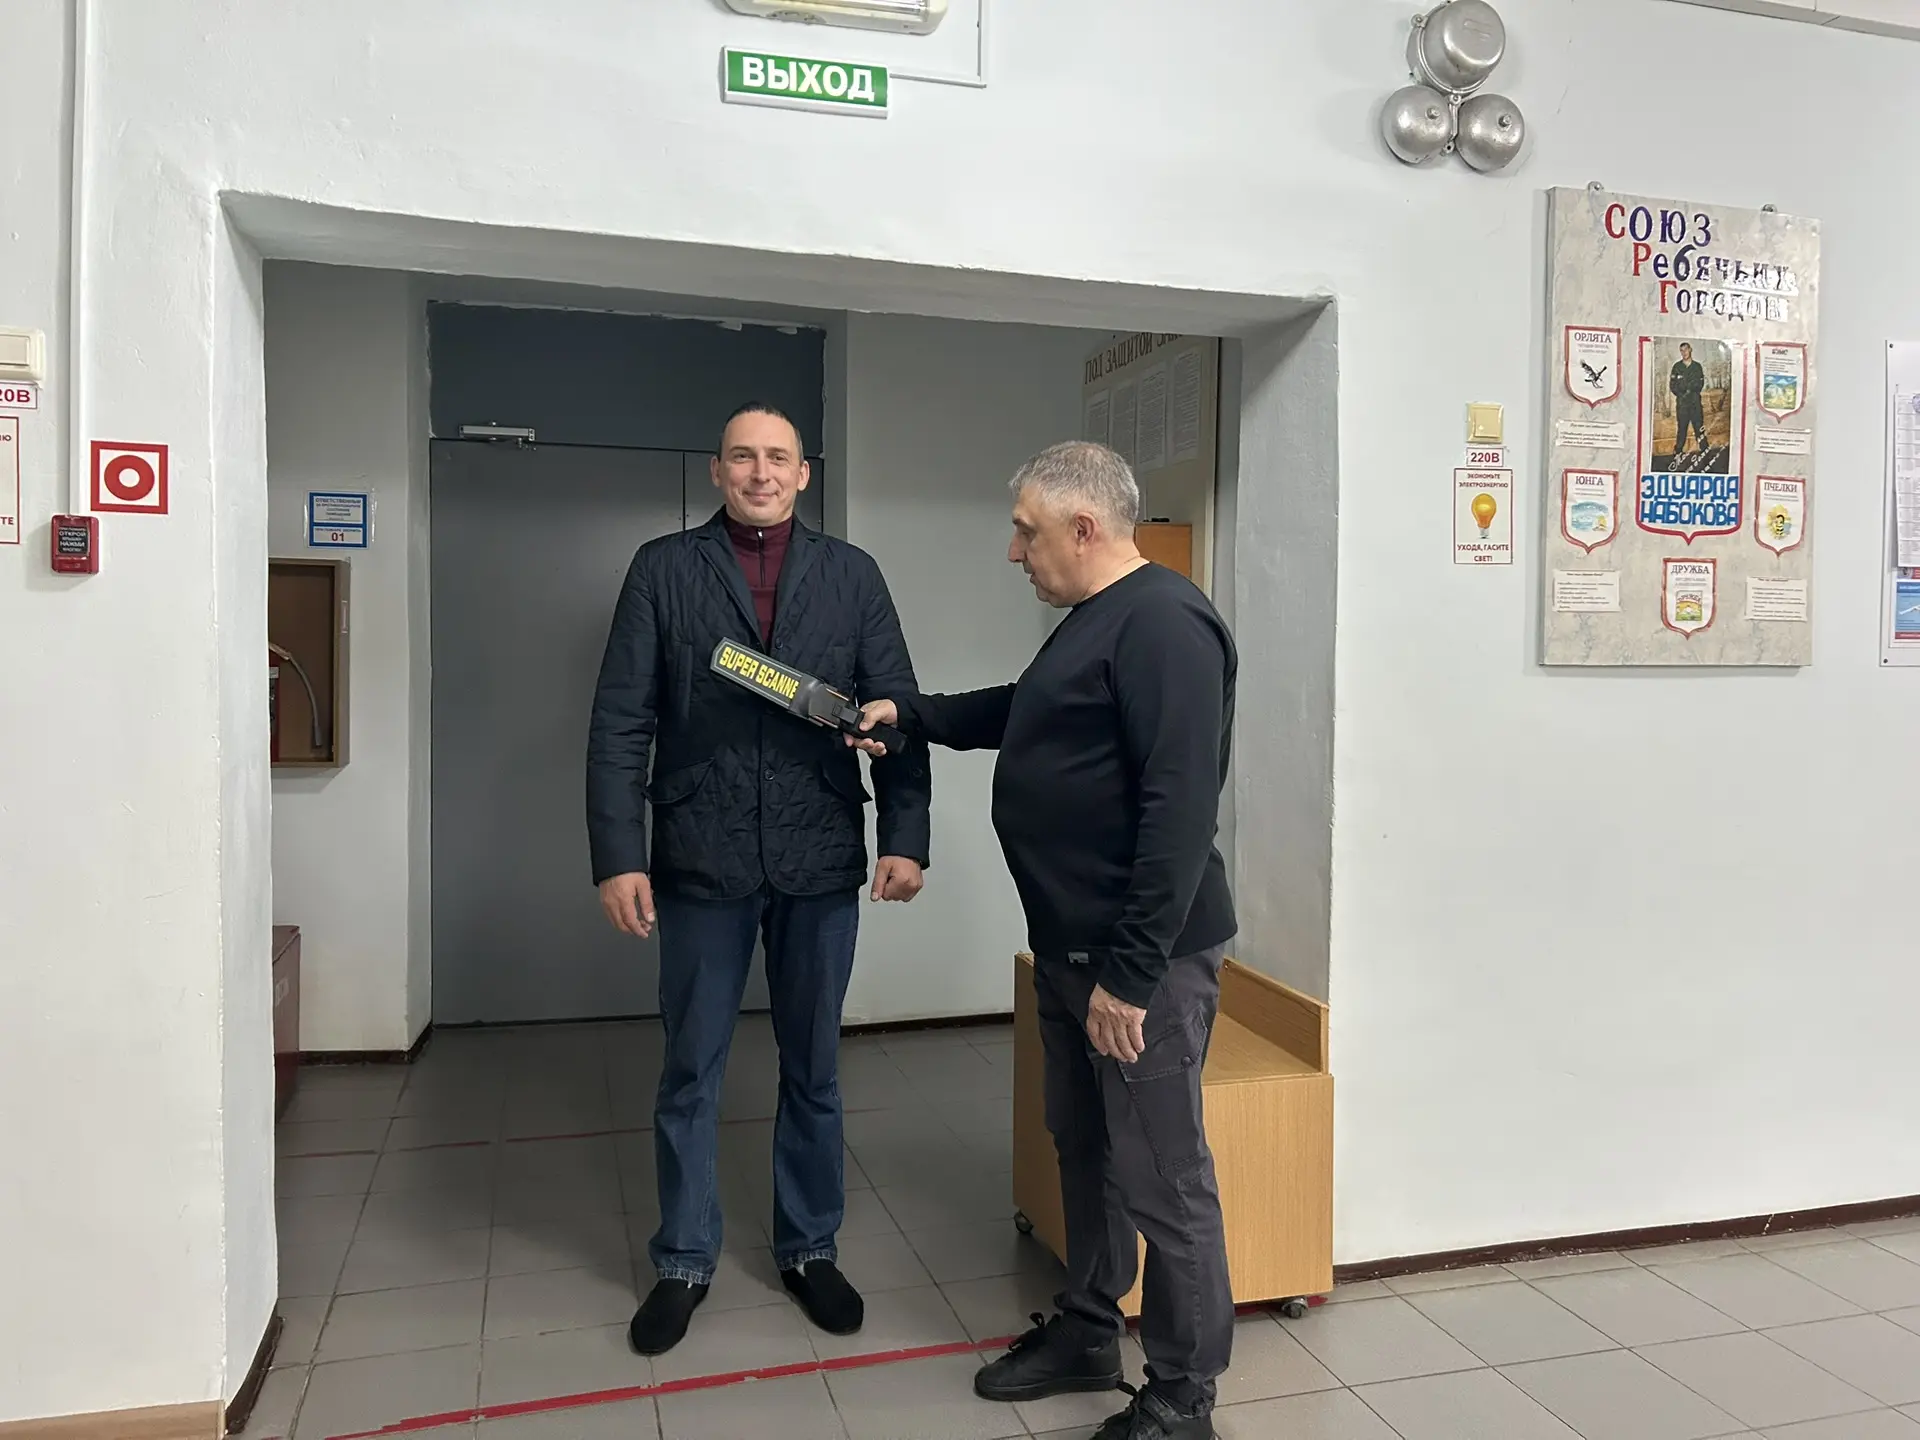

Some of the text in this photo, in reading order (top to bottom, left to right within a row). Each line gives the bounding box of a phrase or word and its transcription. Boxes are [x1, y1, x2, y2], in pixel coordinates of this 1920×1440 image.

[742, 56, 875, 102] ВЫХОД
[1604, 203, 1712, 247] СОЮЗ
[1574, 332, 1612, 343] ОРЛЯТА
[1085, 353, 1103, 385] ПОД
[1470, 452, 1500, 463] 220В
[1575, 476, 1604, 486] ЮНГА
[1641, 475, 1739, 502] ЭДУАРДА
[1764, 482, 1797, 493] ПЧЕЛКИ
[1640, 501, 1738, 525] НАБОКОВА
[331, 532, 345, 541] 01
[1671, 565, 1710, 575] ДРУЖБА
[719, 647, 800, 699] SUPER SCANNE
